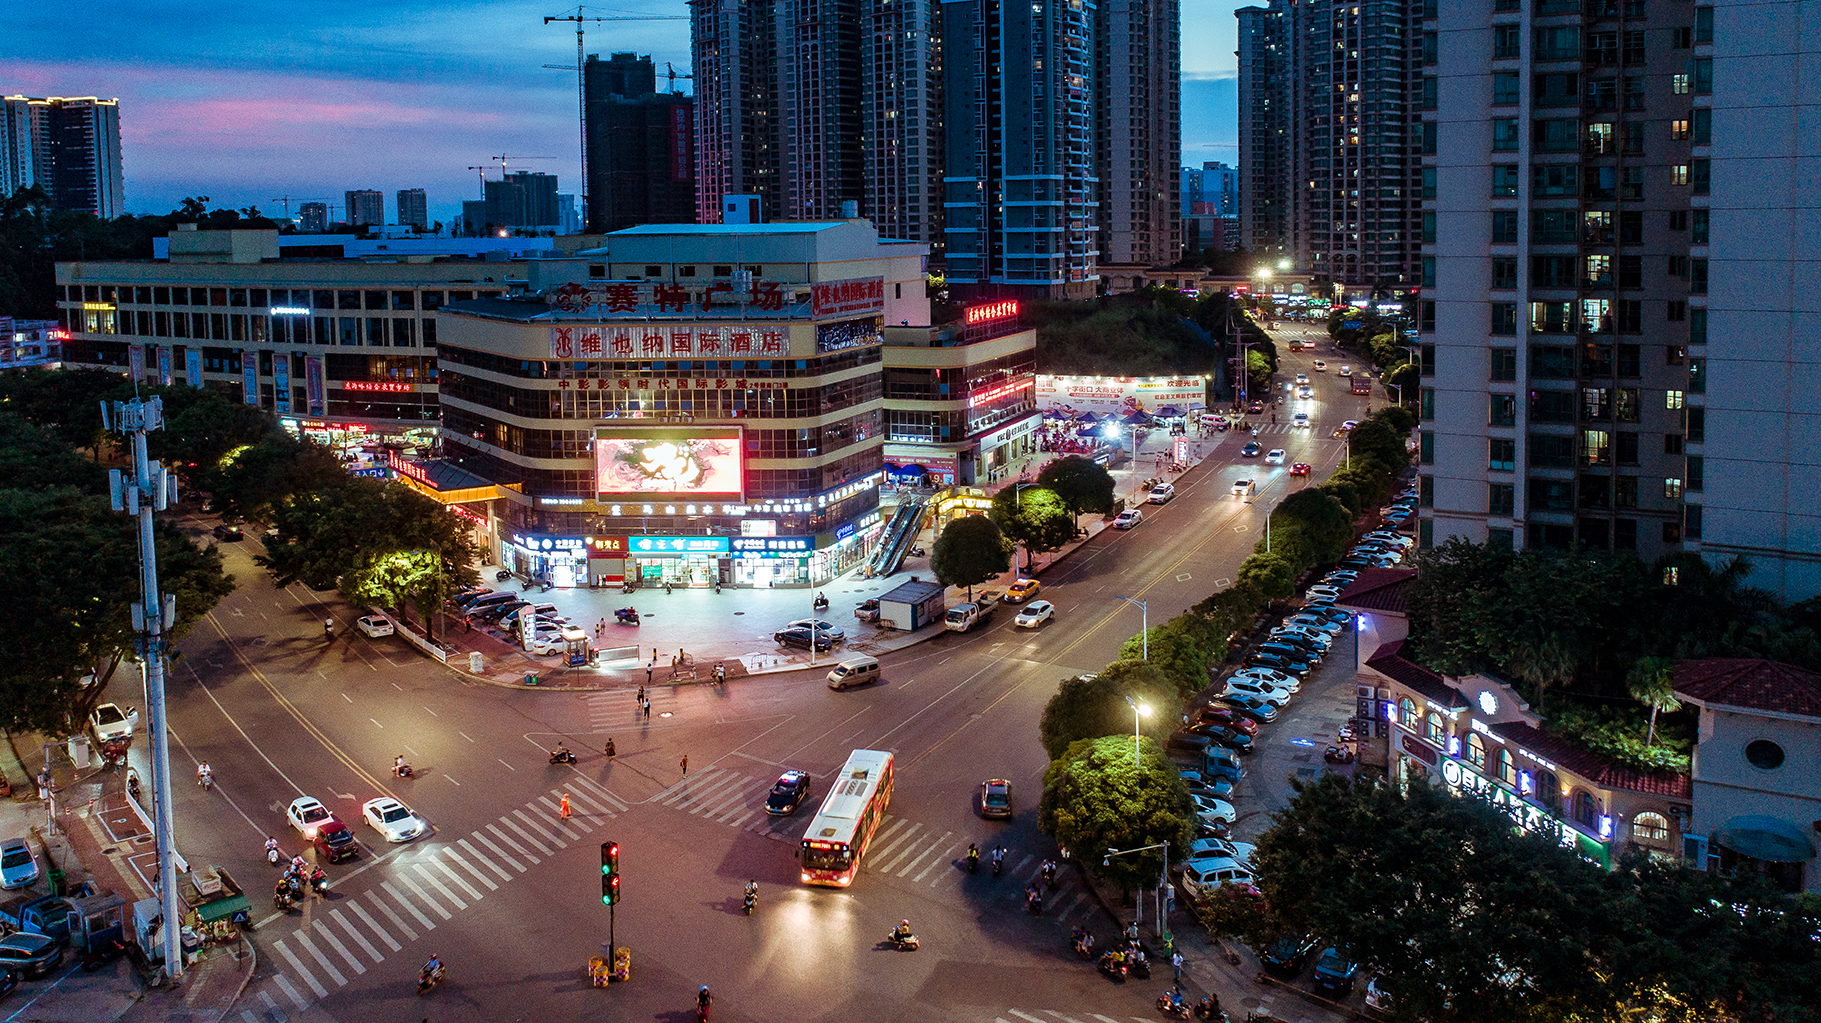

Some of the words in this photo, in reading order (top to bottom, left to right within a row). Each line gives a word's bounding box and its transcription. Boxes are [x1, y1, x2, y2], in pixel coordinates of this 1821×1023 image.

[606, 282, 783, 313] 赛特广场
[580, 332, 783, 354] 维也纳国际酒店
